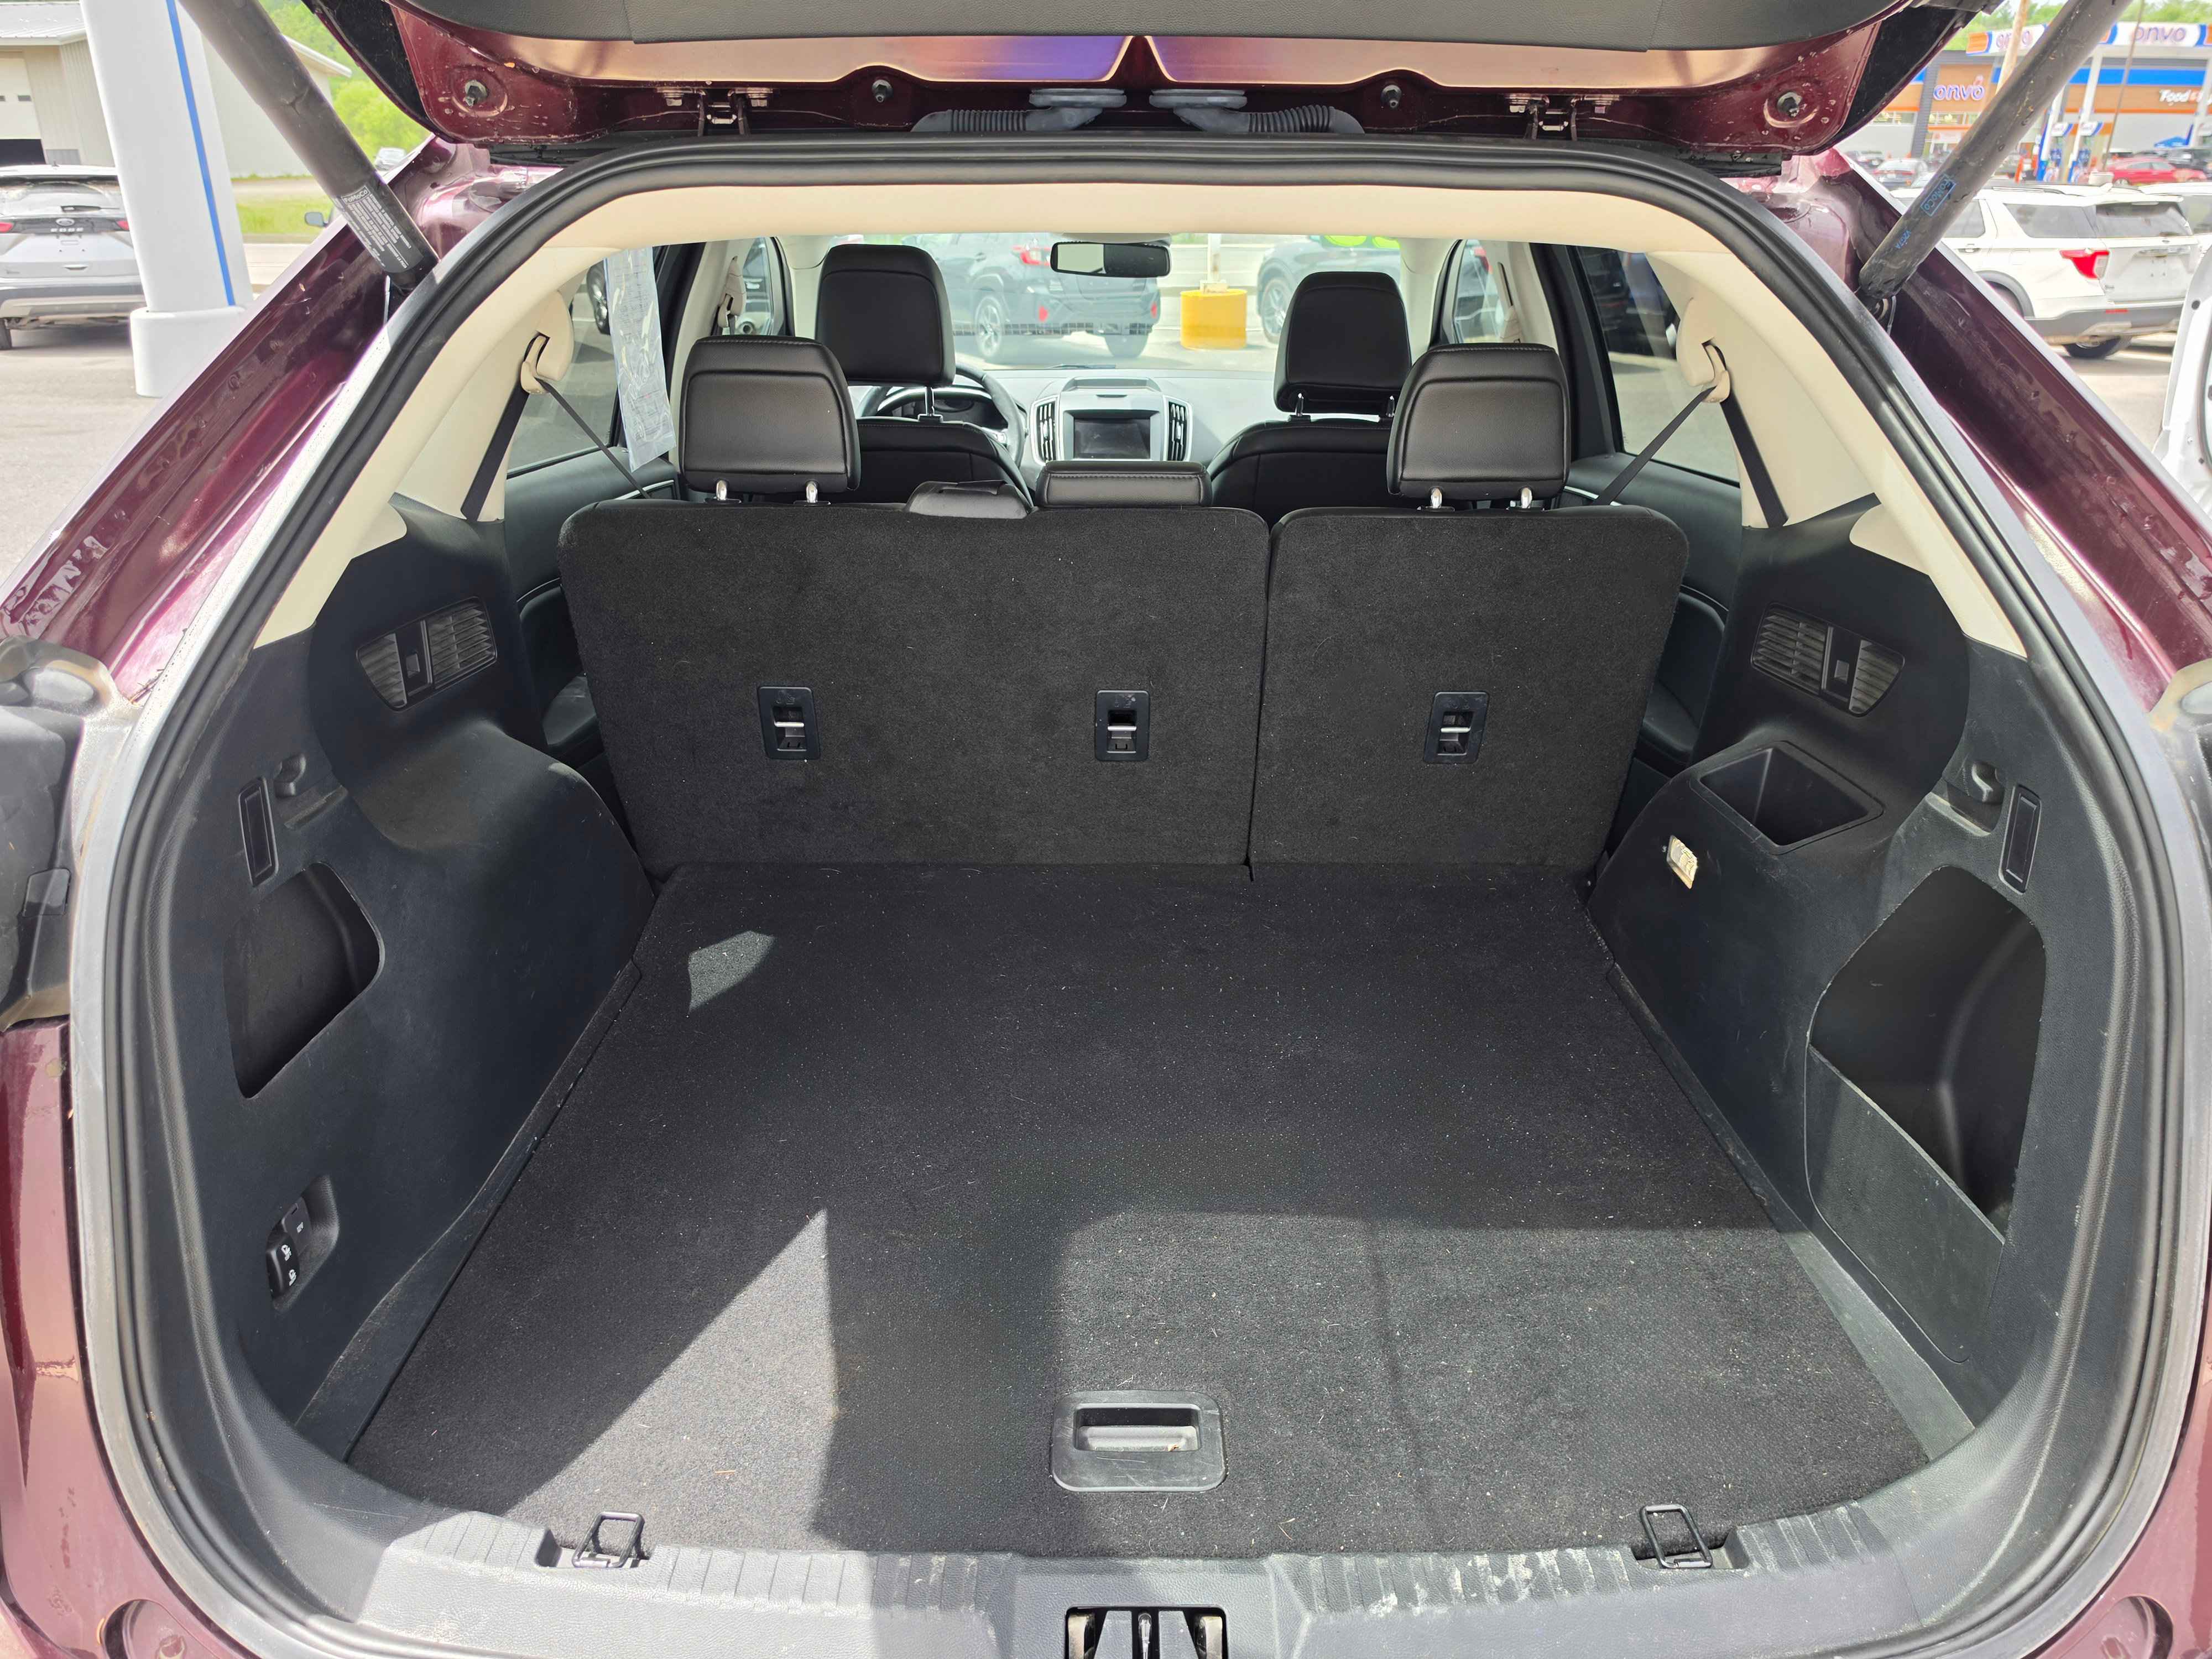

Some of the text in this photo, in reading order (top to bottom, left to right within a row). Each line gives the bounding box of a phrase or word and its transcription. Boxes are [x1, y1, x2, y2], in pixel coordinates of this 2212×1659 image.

[2133, 27, 2187, 42] onvo
[1933, 84, 1984, 101] onvo
[344, 190, 368, 202] FoMoCo
